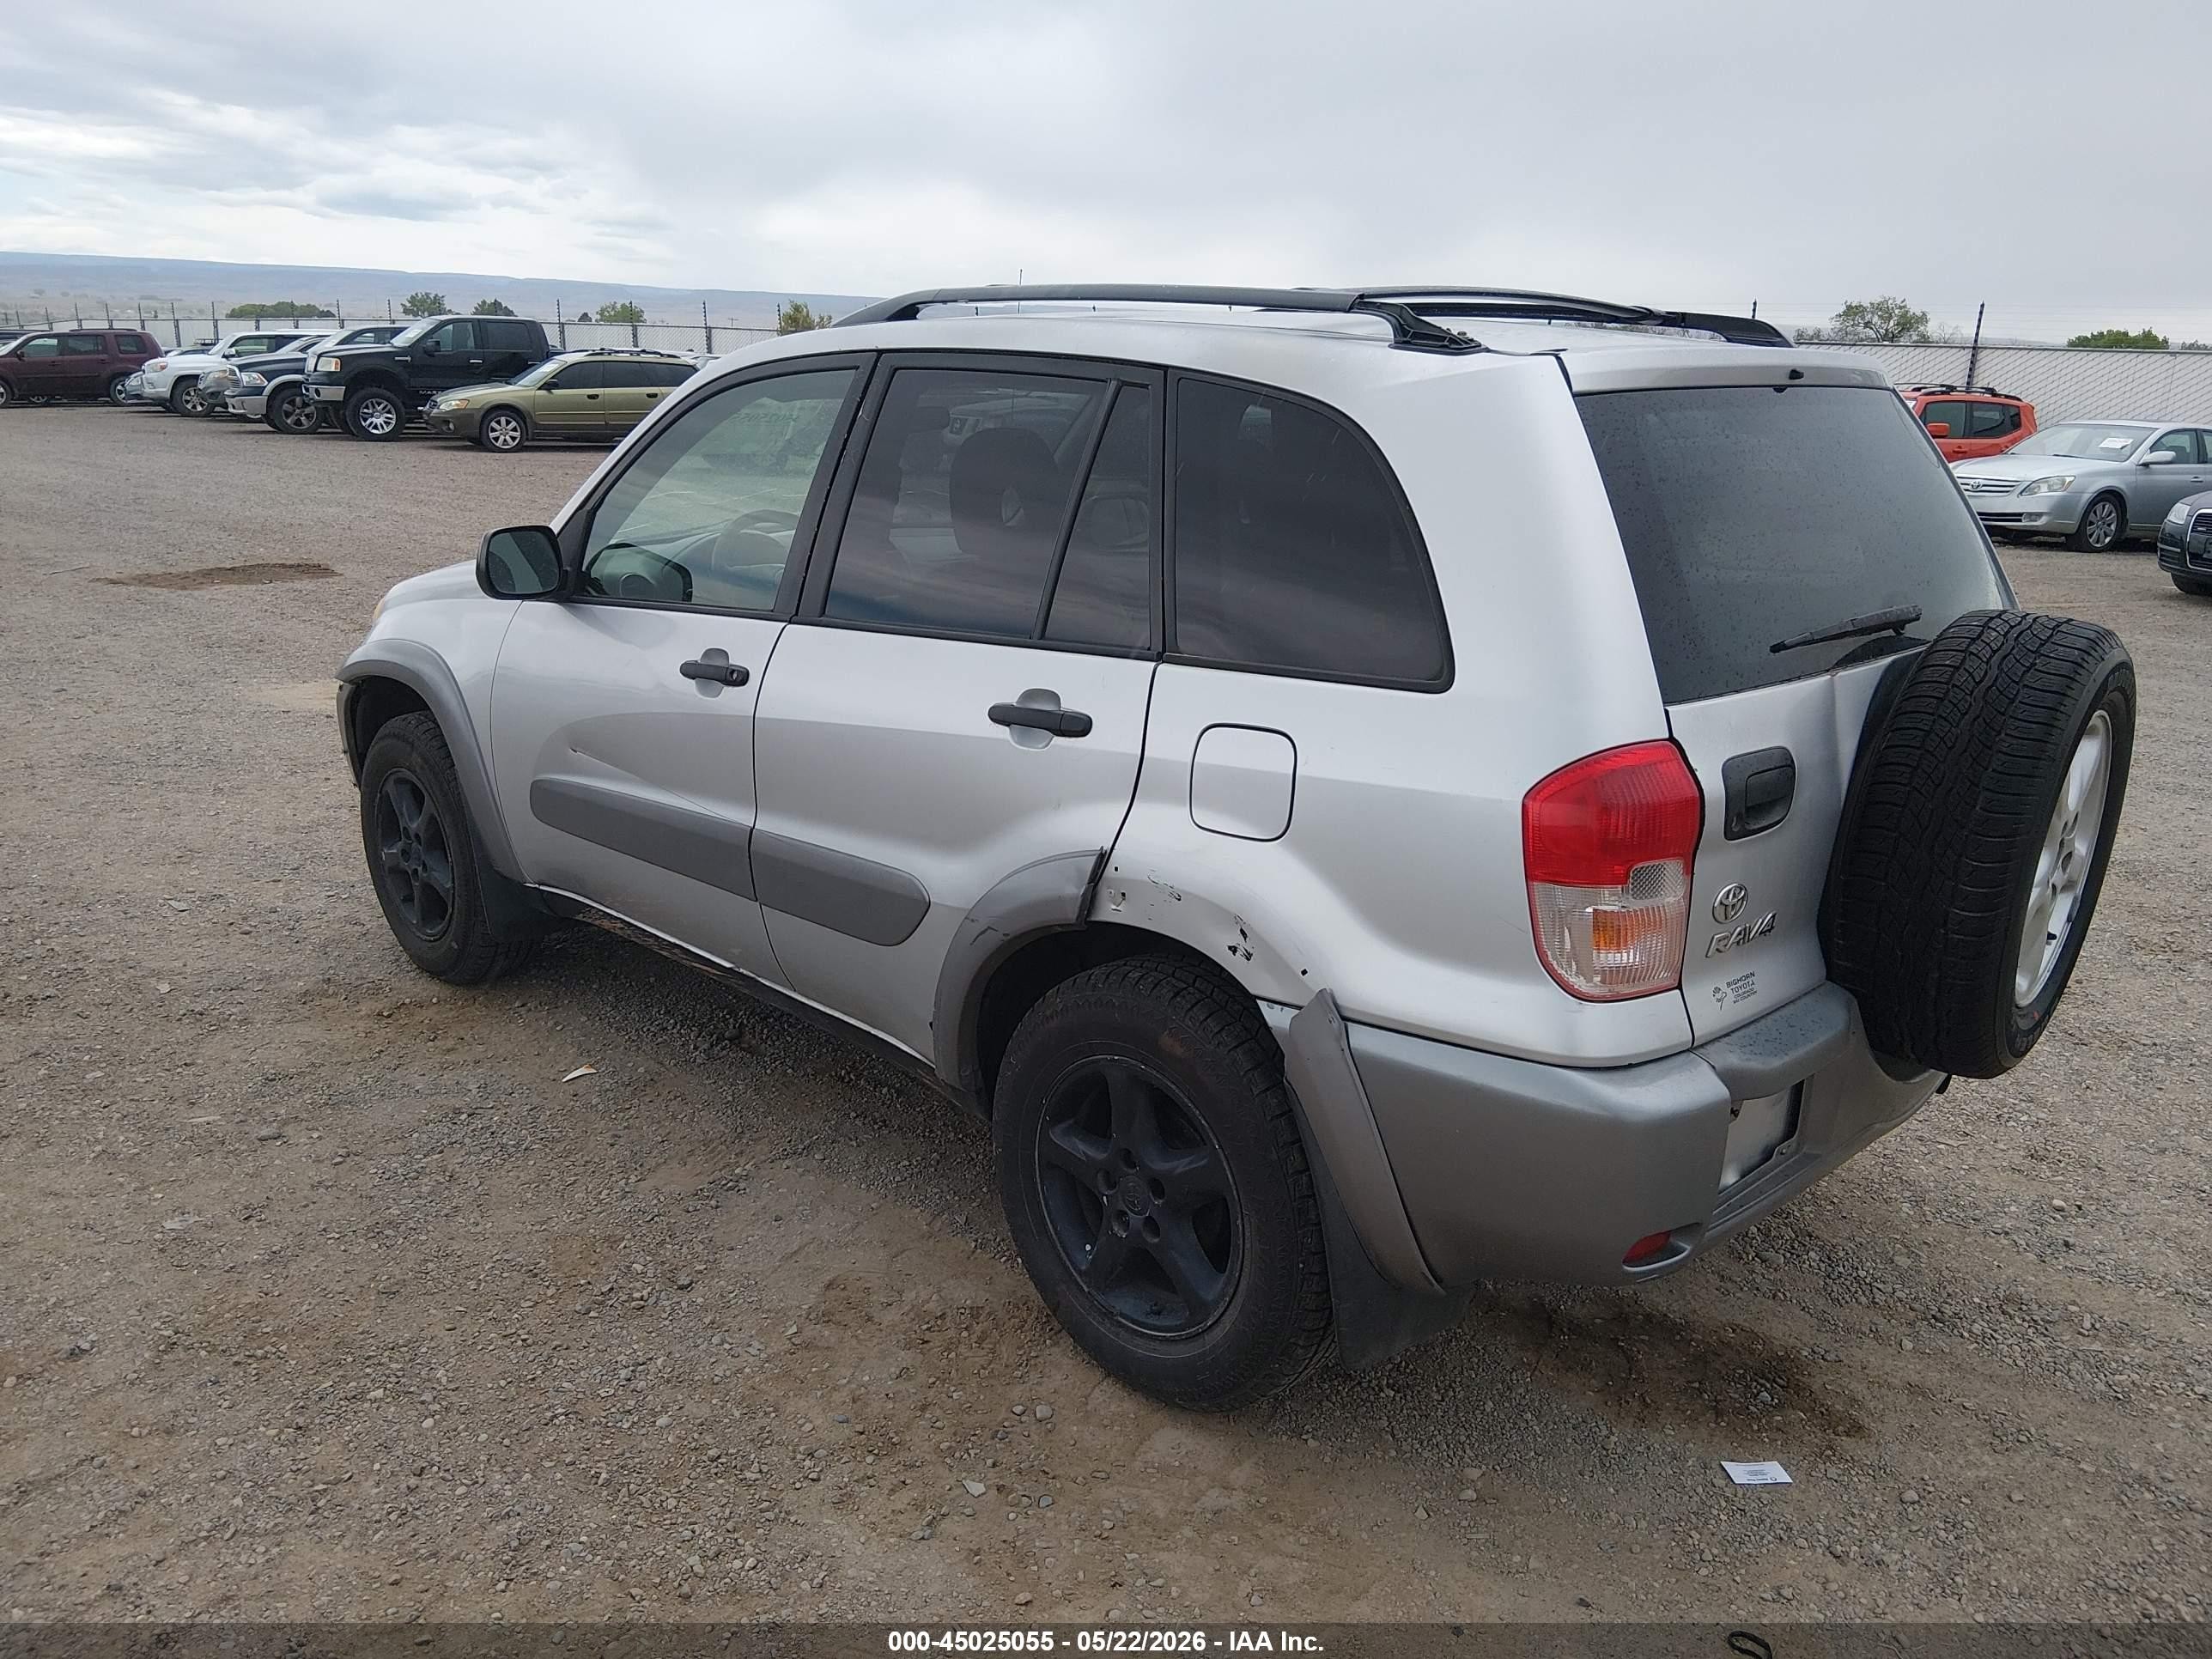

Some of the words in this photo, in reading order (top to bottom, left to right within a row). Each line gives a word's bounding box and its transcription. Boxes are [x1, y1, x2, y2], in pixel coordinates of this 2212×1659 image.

[1705, 912, 1777, 958] RAV4
[1725, 970, 1755, 988] BIGHORN
[1730, 979, 1755, 994] TOYOTA
